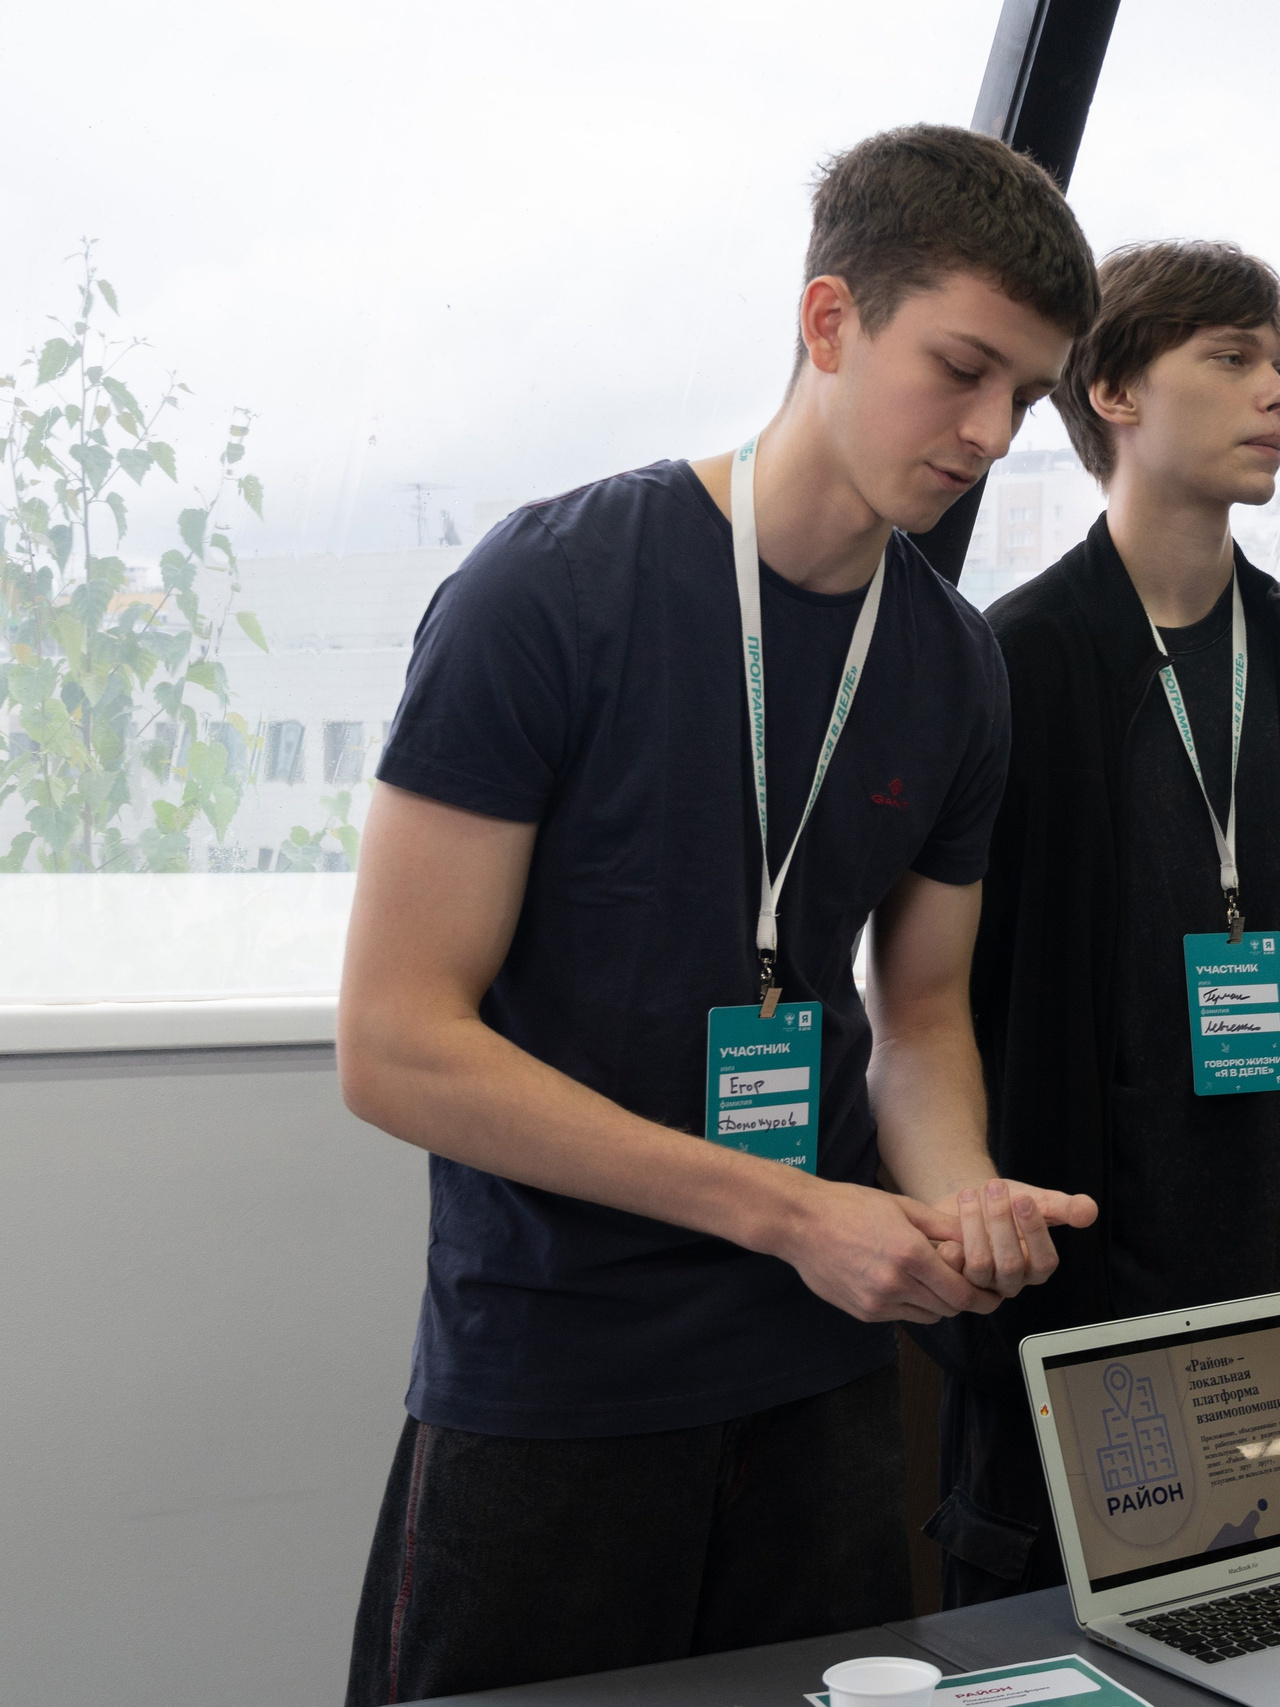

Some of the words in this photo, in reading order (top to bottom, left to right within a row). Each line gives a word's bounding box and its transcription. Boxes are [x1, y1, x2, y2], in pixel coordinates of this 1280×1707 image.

[1235, 653, 1245, 701] ДЕЛЕ»
[747, 635, 763, 760] ПРОГРАММА
[1234, 701, 1242, 712] В
[824, 738, 834, 760] «Я
[831, 724, 840, 737] В
[836, 665, 858, 724] ДЕЛЕ»
[1161, 668, 1194, 752] РОГРАММА
[1196, 963, 1259, 975] УЧАСТНИК
[719, 1042, 791, 1058] УЧАСТНИК
[1204, 1058, 1245, 1068] ГОВОРЮ
[1215, 1069, 1228, 1078] «Я
[1229, 1068, 1238, 1077] В
[1238, 1066, 1275, 1078] ДЕЛЕ»
[730, 1076, 765, 1095] Егор
[720, 1100, 753, 1110] фамилия
[1185, 1356, 1235, 1373] «Район»
[1189, 1370, 1252, 1390] локальная
[1192, 1385, 1260, 1408] платформа
[1106, 1482, 1185, 1516] РАЙОН
[955, 1685, 1013, 1699] РАЙОН
